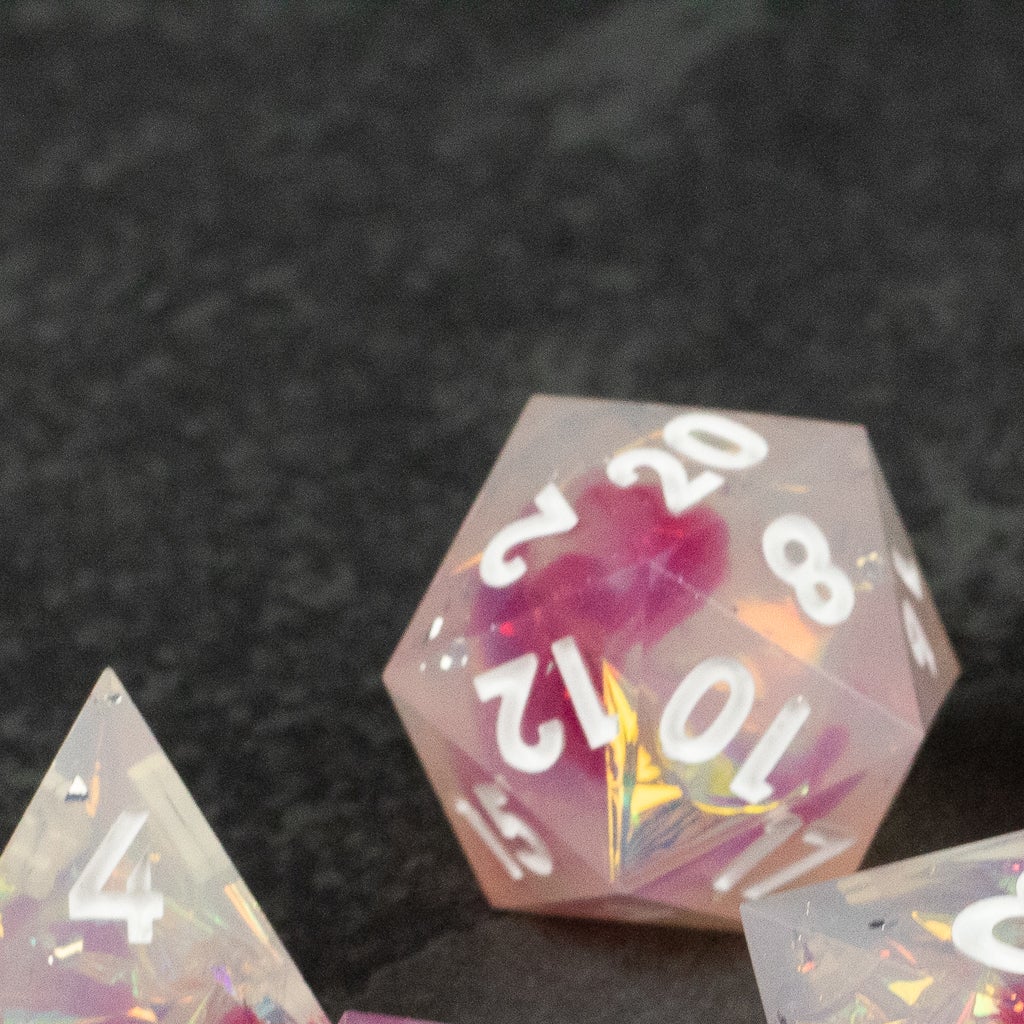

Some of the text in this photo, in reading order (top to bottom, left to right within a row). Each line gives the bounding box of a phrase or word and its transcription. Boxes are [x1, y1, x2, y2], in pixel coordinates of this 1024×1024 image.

[607, 411, 768, 515] 20
[479, 483, 579, 589] 2
[762, 513, 855, 626] 8
[473, 637, 619, 773] 12
[660, 657, 811, 803] 10
[69, 811, 163, 943] 4
[455, 783, 553, 880] 15
[713, 808, 858, 900] 17
